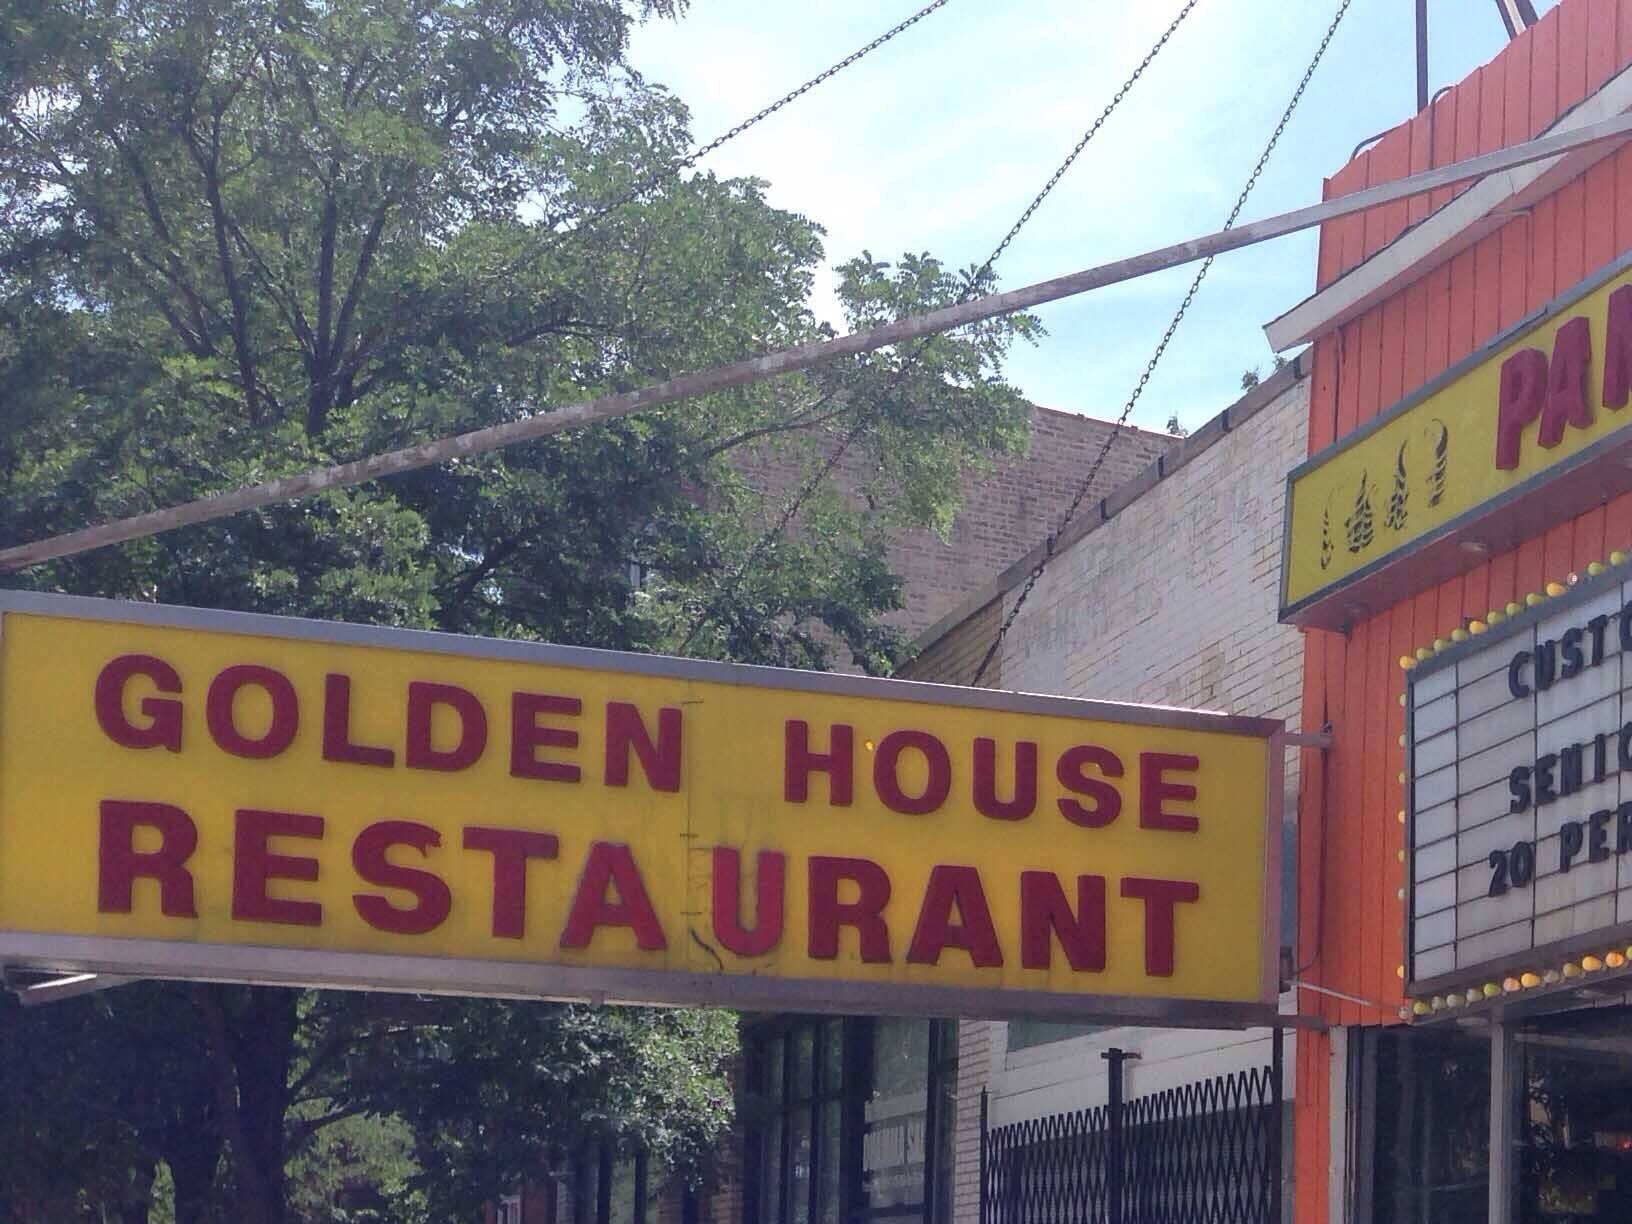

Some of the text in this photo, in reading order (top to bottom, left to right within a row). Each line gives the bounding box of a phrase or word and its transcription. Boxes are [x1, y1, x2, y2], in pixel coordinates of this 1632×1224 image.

[95, 654, 1199, 832] GOLDEN HOUSE
[98, 800, 1199, 978] RESTAURANT
[1488, 840, 1534, 897] 20
